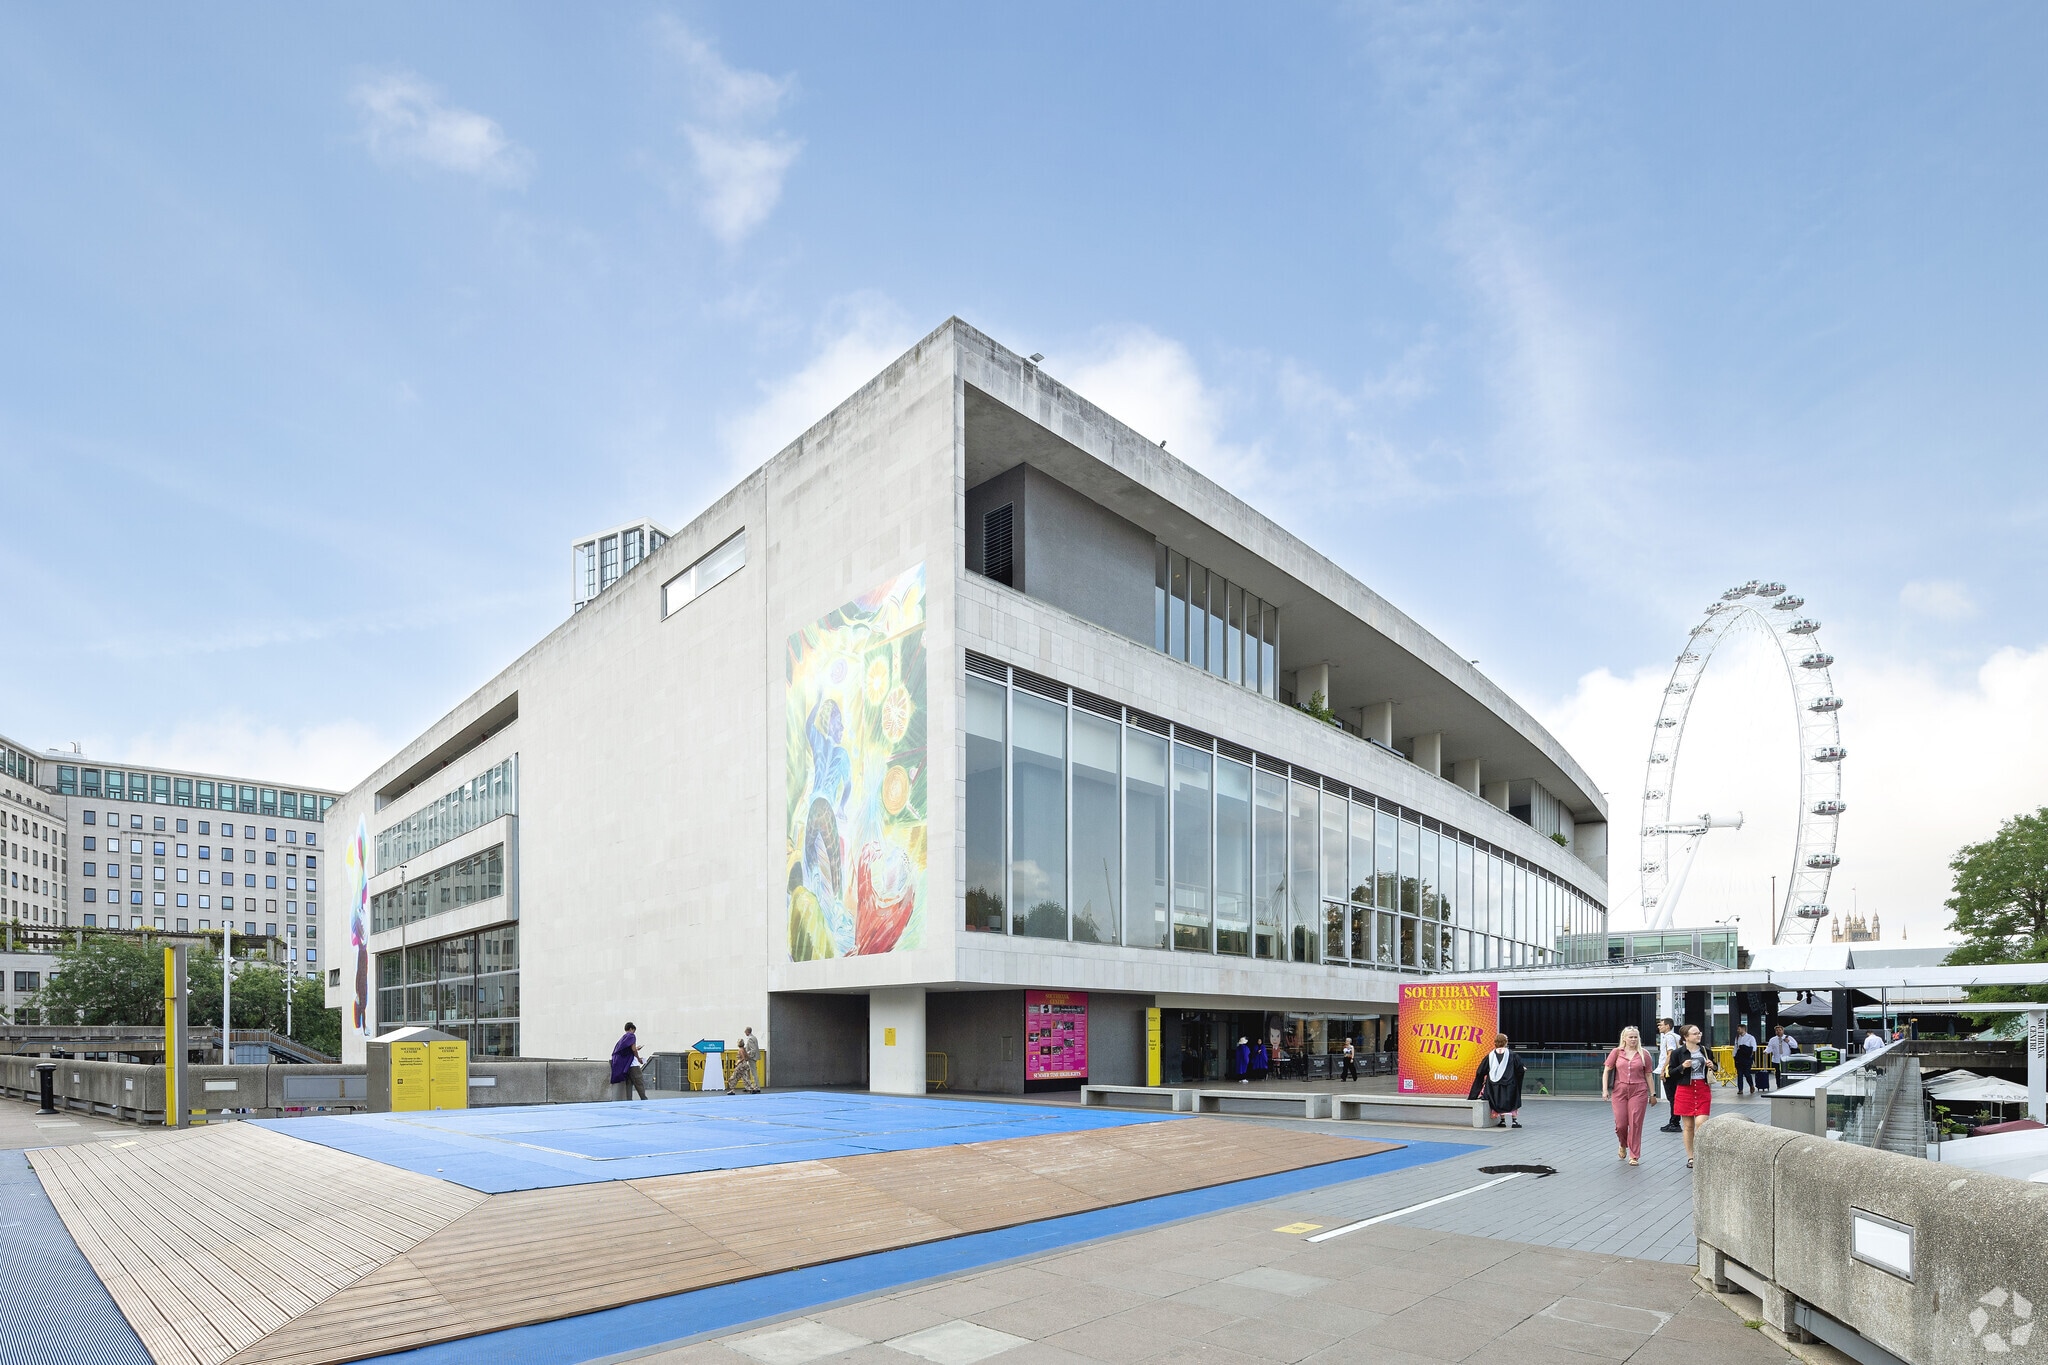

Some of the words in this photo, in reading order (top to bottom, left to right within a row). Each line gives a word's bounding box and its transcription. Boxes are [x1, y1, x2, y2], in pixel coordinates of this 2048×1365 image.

[1404, 985, 1491, 999] SOUTHBANK
[1420, 999, 1475, 1011] CENTRE
[1411, 1023, 1484, 1045] SUMMER
[2029, 1025, 2037, 1052] CENTRE
[2037, 1017, 2045, 1059] SOUTHBANK
[1419, 1039, 1461, 1060] TIME
